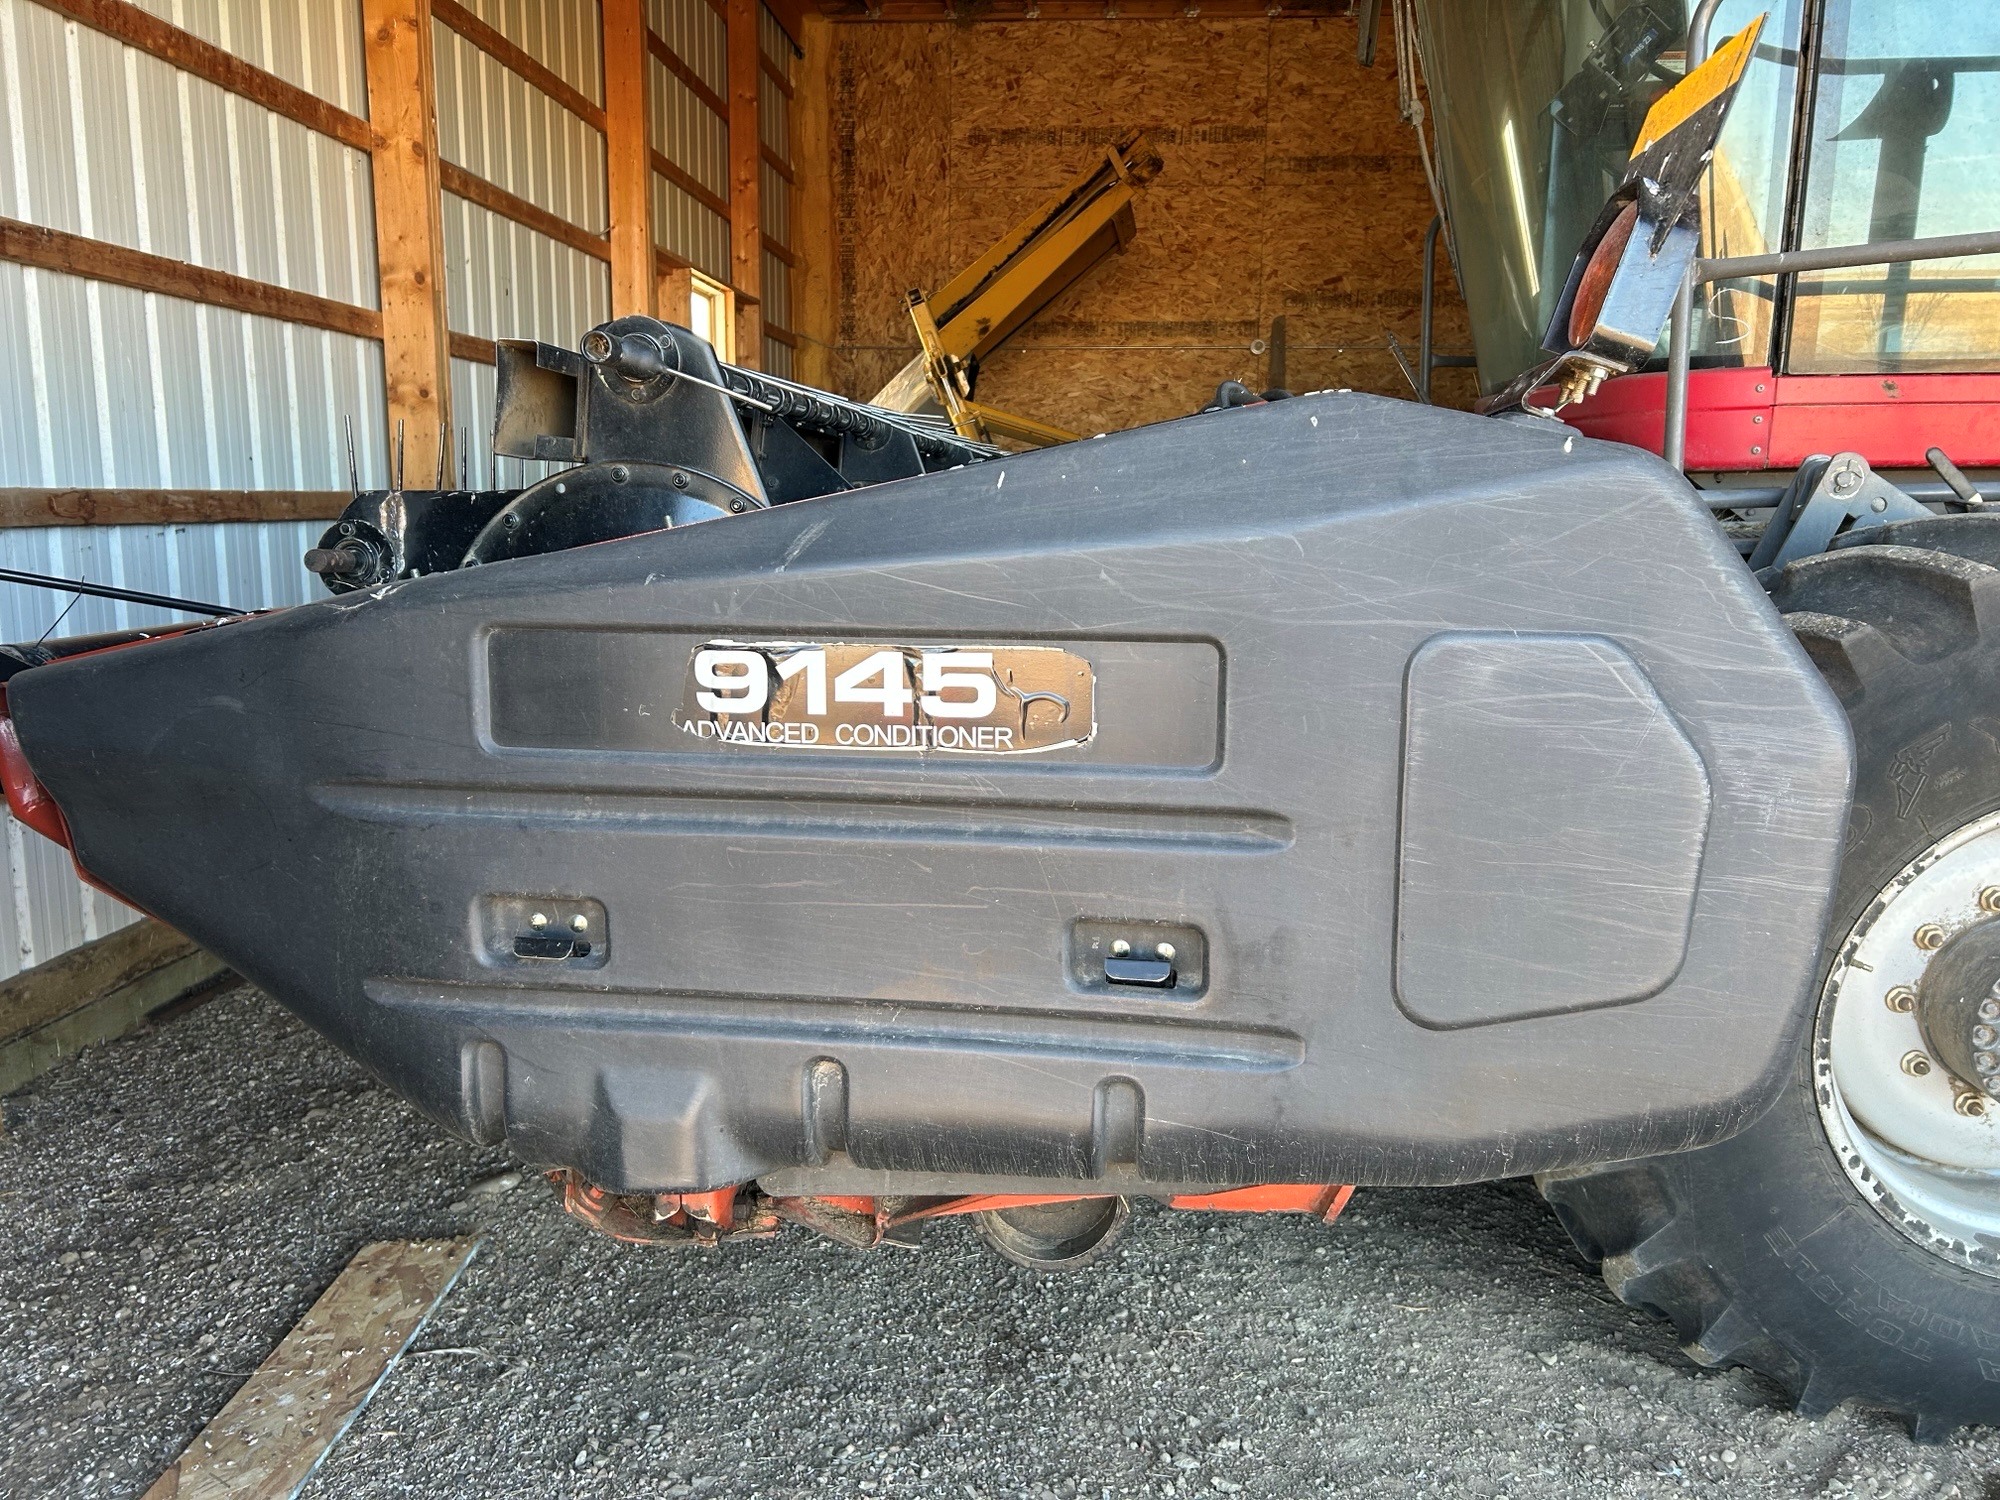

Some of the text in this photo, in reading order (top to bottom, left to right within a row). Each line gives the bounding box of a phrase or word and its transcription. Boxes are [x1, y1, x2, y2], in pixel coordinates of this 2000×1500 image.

[694, 650, 997, 718] 9145
[682, 720, 1014, 749] ADVANCED CONDITIONER
[1762, 1225, 1932, 1363] TORQUE
